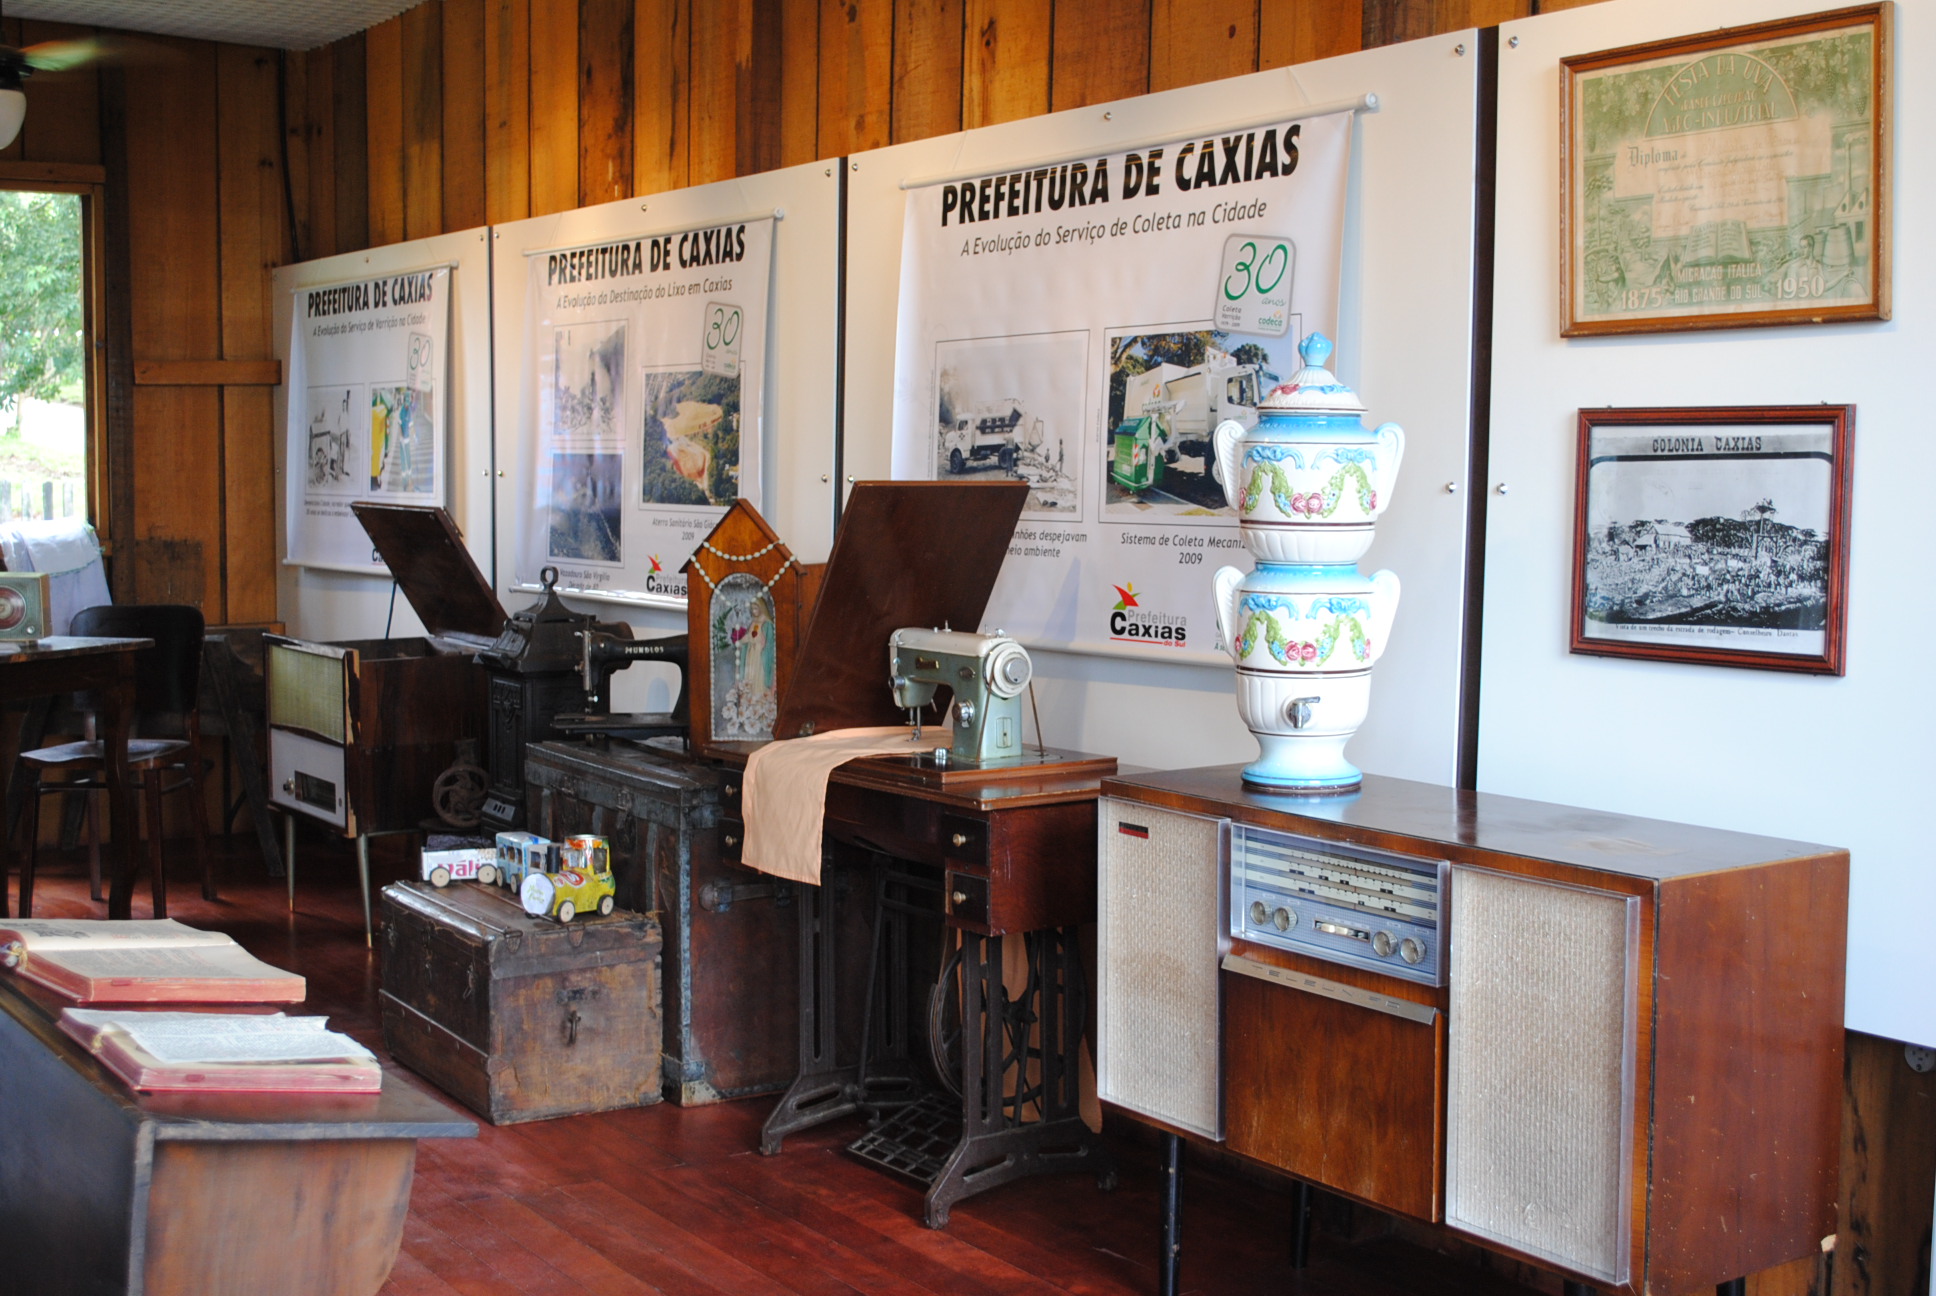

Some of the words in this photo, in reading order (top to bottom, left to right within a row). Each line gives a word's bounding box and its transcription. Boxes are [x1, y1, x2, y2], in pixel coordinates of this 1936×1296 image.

[1663, 61, 1710, 106] FESTA
[1717, 55, 1735, 76] DA
[1744, 59, 1773, 93] UVA
[1627, 146, 1679, 168] Diploma
[941, 158, 1109, 227] PREFEITURA
[1122, 148, 1164, 200] DE
[1174, 123, 1302, 192] CAXIAS
[960, 239, 969, 257] A
[973, 231, 1030, 255] Evolução
[1034, 228, 1051, 246] do
[1055, 221, 1105, 245] Serviço
[1110, 217, 1128, 237] de
[1133, 211, 1181, 234] Coleta
[1187, 210, 1206, 227] na
[1212, 198, 1267, 224] Cidade
[548, 241, 643, 287] PREFEITURA
[650, 235, 672, 273] DE
[678, 224, 746, 269] CAXIAS
[1224, 241, 1288, 301] 30
[307, 283, 370, 318] PREFEITURA
[373, 279, 388, 309] DE
[391, 272, 433, 305] CAXIAS
[556, 296, 562, 310] A
[563, 292, 596, 309] Evolução
[609, 284, 653, 303] Destinação
[655, 284, 666, 298] do
[667, 281, 686, 297] Lixo
[688, 281, 701, 295] em
[703, 275, 733, 293] Caxias
[1674, 288, 1690, 304] RIO
[1692, 286, 1726, 302] GRANDE
[1745, 283, 1762, 298] SUL
[1776, 274, 1825, 299] 1950
[1620, 286, 1664, 311] 1875
[317, 322, 340, 337] Evolução
[348, 320, 367, 334] Serviço
[367, 318, 374, 331] de
[706, 308, 740, 350] 30
[1652, 437, 1704, 453] COLONIA
[1713, 436, 1762, 452] CAXIAS
[1038, 529, 1087, 544] despejavam
[1121, 532, 1156, 546] Sistema
[1158, 533, 1170, 547] de
[1172, 534, 1204, 548] Coleta
[1024, 545, 1061, 558] ambiente
[1178, 551, 1203, 565] 2009
[646, 575, 687, 596] Caxias
[1110, 611, 1187, 641] Caxias
[1127, 609, 1187, 626] Prefeitura
[625, 646, 664, 654] MUNDLOS
